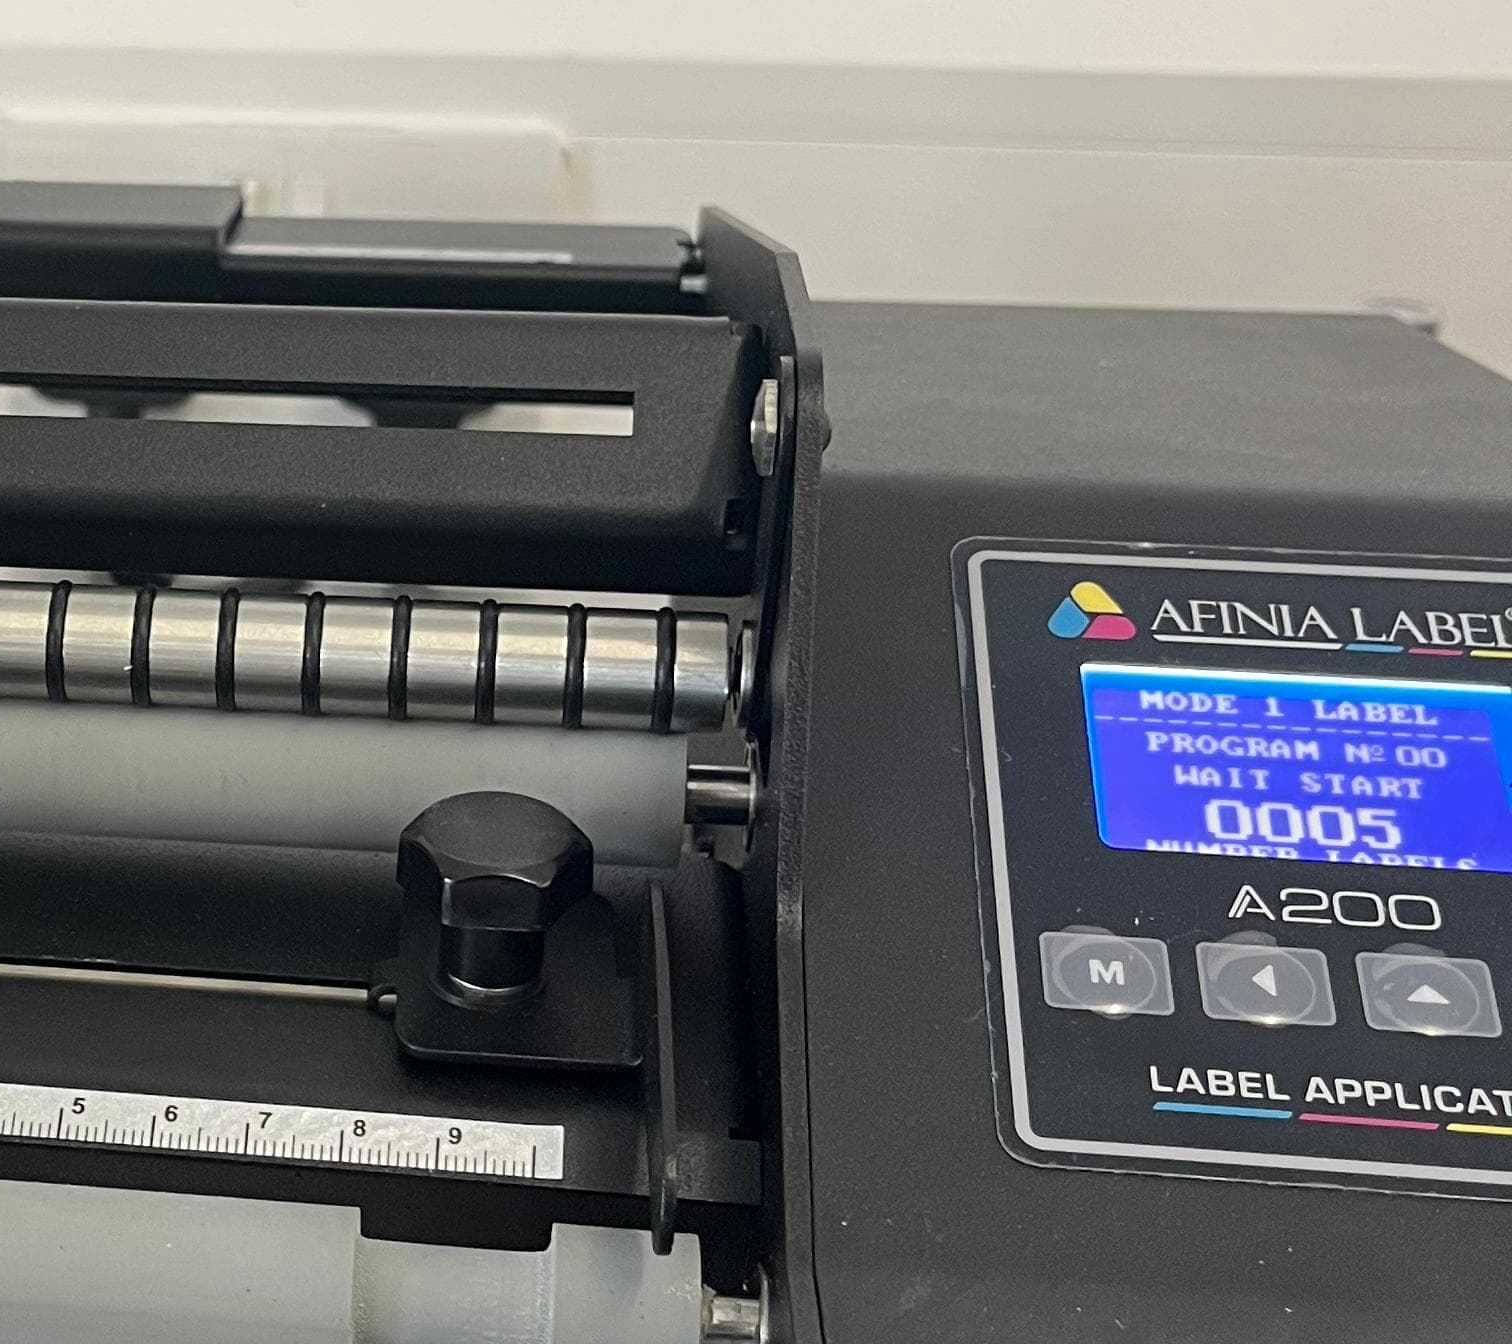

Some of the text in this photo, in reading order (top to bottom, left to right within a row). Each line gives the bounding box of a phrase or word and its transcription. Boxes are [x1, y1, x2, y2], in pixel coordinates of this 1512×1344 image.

[1151, 599, 1338, 640] AFINIA
[1139, 690, 1439, 727] MODE 1 LABEL
[1145, 731, 1320, 761] PROGRAM
[1174, 764, 1424, 800] WAIT START
[1204, 799, 1403, 850] 0005
[1228, 884, 1443, 930] A200
[1089, 959, 1126, 987] M
[1149, 1065, 1291, 1101] LABEL
[71, 1097, 87, 1114] 5
[164, 1105, 179, 1122] 6
[257, 1111, 273, 1130] 7
[352, 1119, 368, 1137] 8
[447, 1127, 463, 1145] 9
